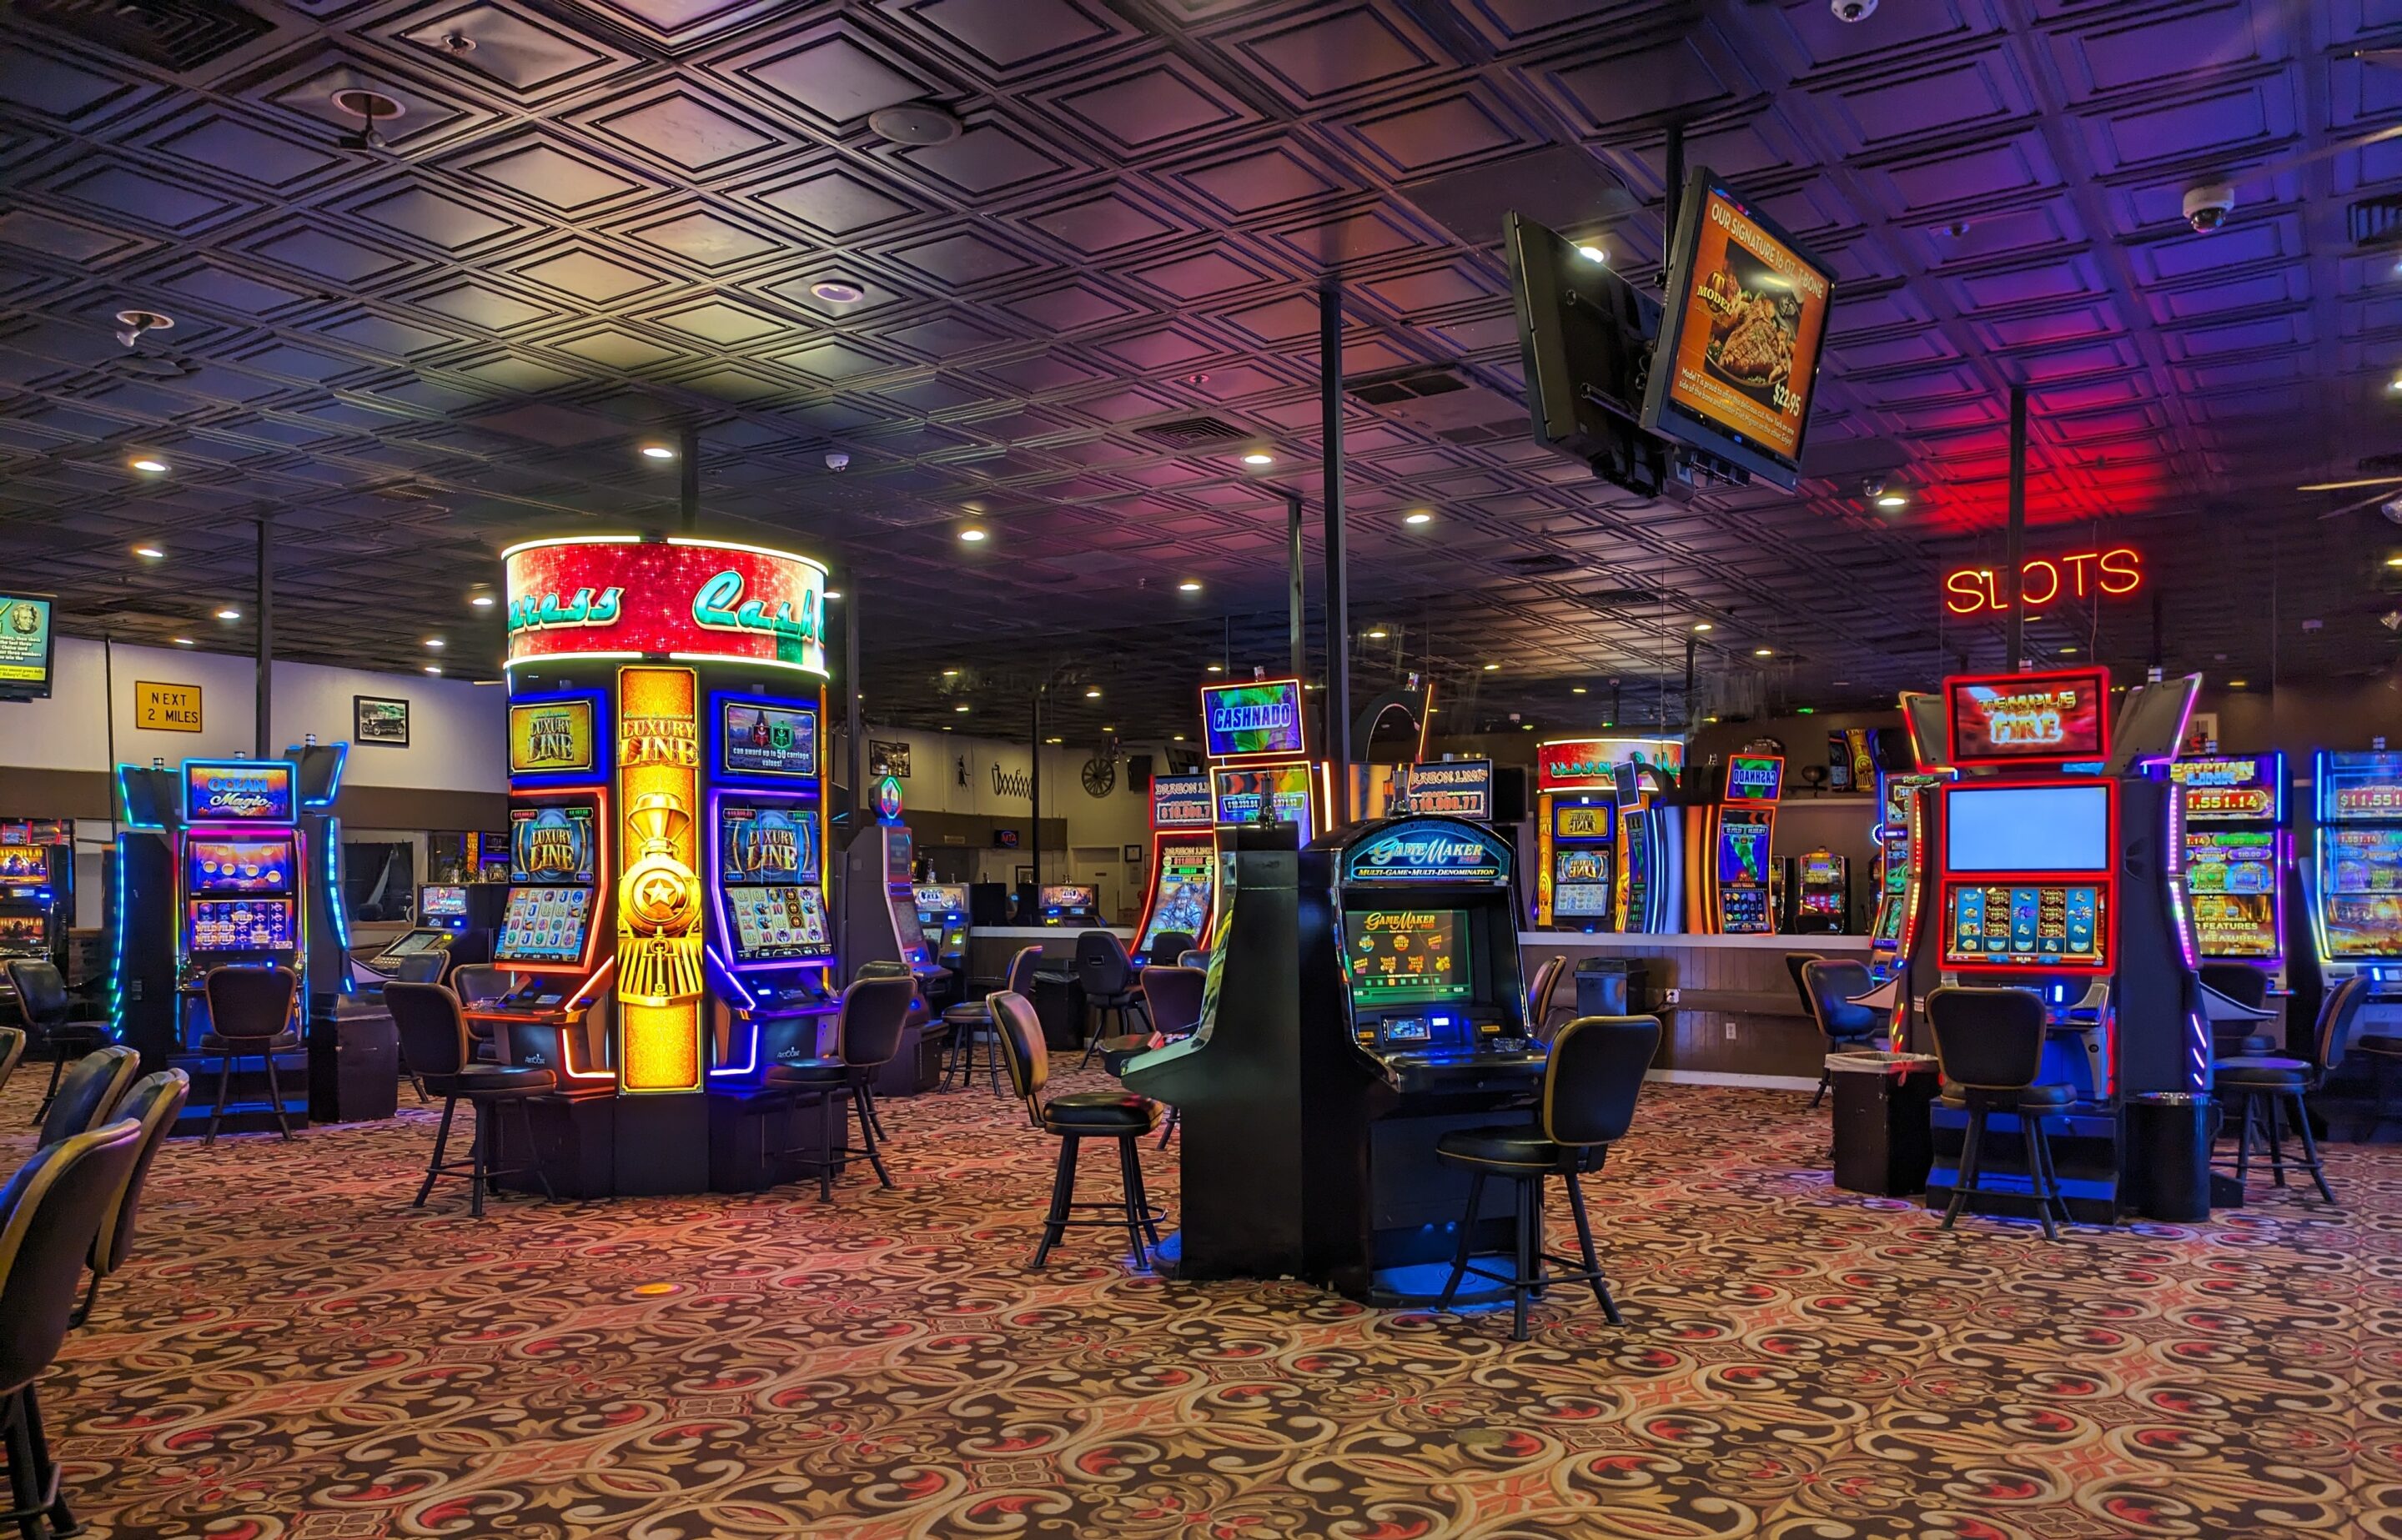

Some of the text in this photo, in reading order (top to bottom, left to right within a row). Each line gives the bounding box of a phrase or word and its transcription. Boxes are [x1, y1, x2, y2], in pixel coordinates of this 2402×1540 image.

[1711, 203, 1731, 230] OUR
[1731, 218, 1777, 263] SIGNATURE
[1776, 252, 1784, 268] 16
[1798, 268, 1824, 299] T-BONE
[1696, 285, 1731, 316] MODEL
[1681, 367, 1697, 381] Model
[1704, 381, 1718, 393] proud
[1773, 380, 1801, 417] $22.95
[1947, 549, 2140, 613] SLOTS
[691, 570, 814, 641] Cash
[151, 692, 188, 706] NEXT
[1977, 691, 2077, 712] TEMPLE
[148, 708, 198, 724] 2 MILES
[1214, 703, 1292, 733] CASHNADO
[530, 718, 572, 735] LUXURY
[622, 720, 696, 739] LUXURY
[1992, 715, 2062, 743] FIRE
[527, 734, 575, 764] LINE
[618, 736, 700, 768] LINE
[745, 748, 762, 756] award
[771, 749, 776, 757] to
[776, 749, 786, 760] 50
[786, 751, 810, 760] carriage
[761, 760, 782, 768] values!
[2170, 761, 2255, 779] EGYPTIAN
[208, 777, 269, 793] OCEAN
[1411, 771, 1454, 785] RAGON
[2187, 772, 2238, 785] LINK
[209, 792, 269, 810] Magic
[533, 830, 573, 845] LUXURY
[750, 830, 796, 845] LUXURY
[530, 843, 575, 872] LINE
[746, 844, 797, 871] LINE
[1457, 855, 1483, 865] HD
[528, 904, 537, 916] J
[772, 903, 783, 915] 10
[510, 919, 520, 931] 10
[2203, 922, 2259, 931] FEATURES
[507, 931, 516, 944] 9
[521, 932, 531, 945] J
[535, 931, 545, 945] 9
[550, 932, 560, 945] J
[761, 931, 772, 943] 10
